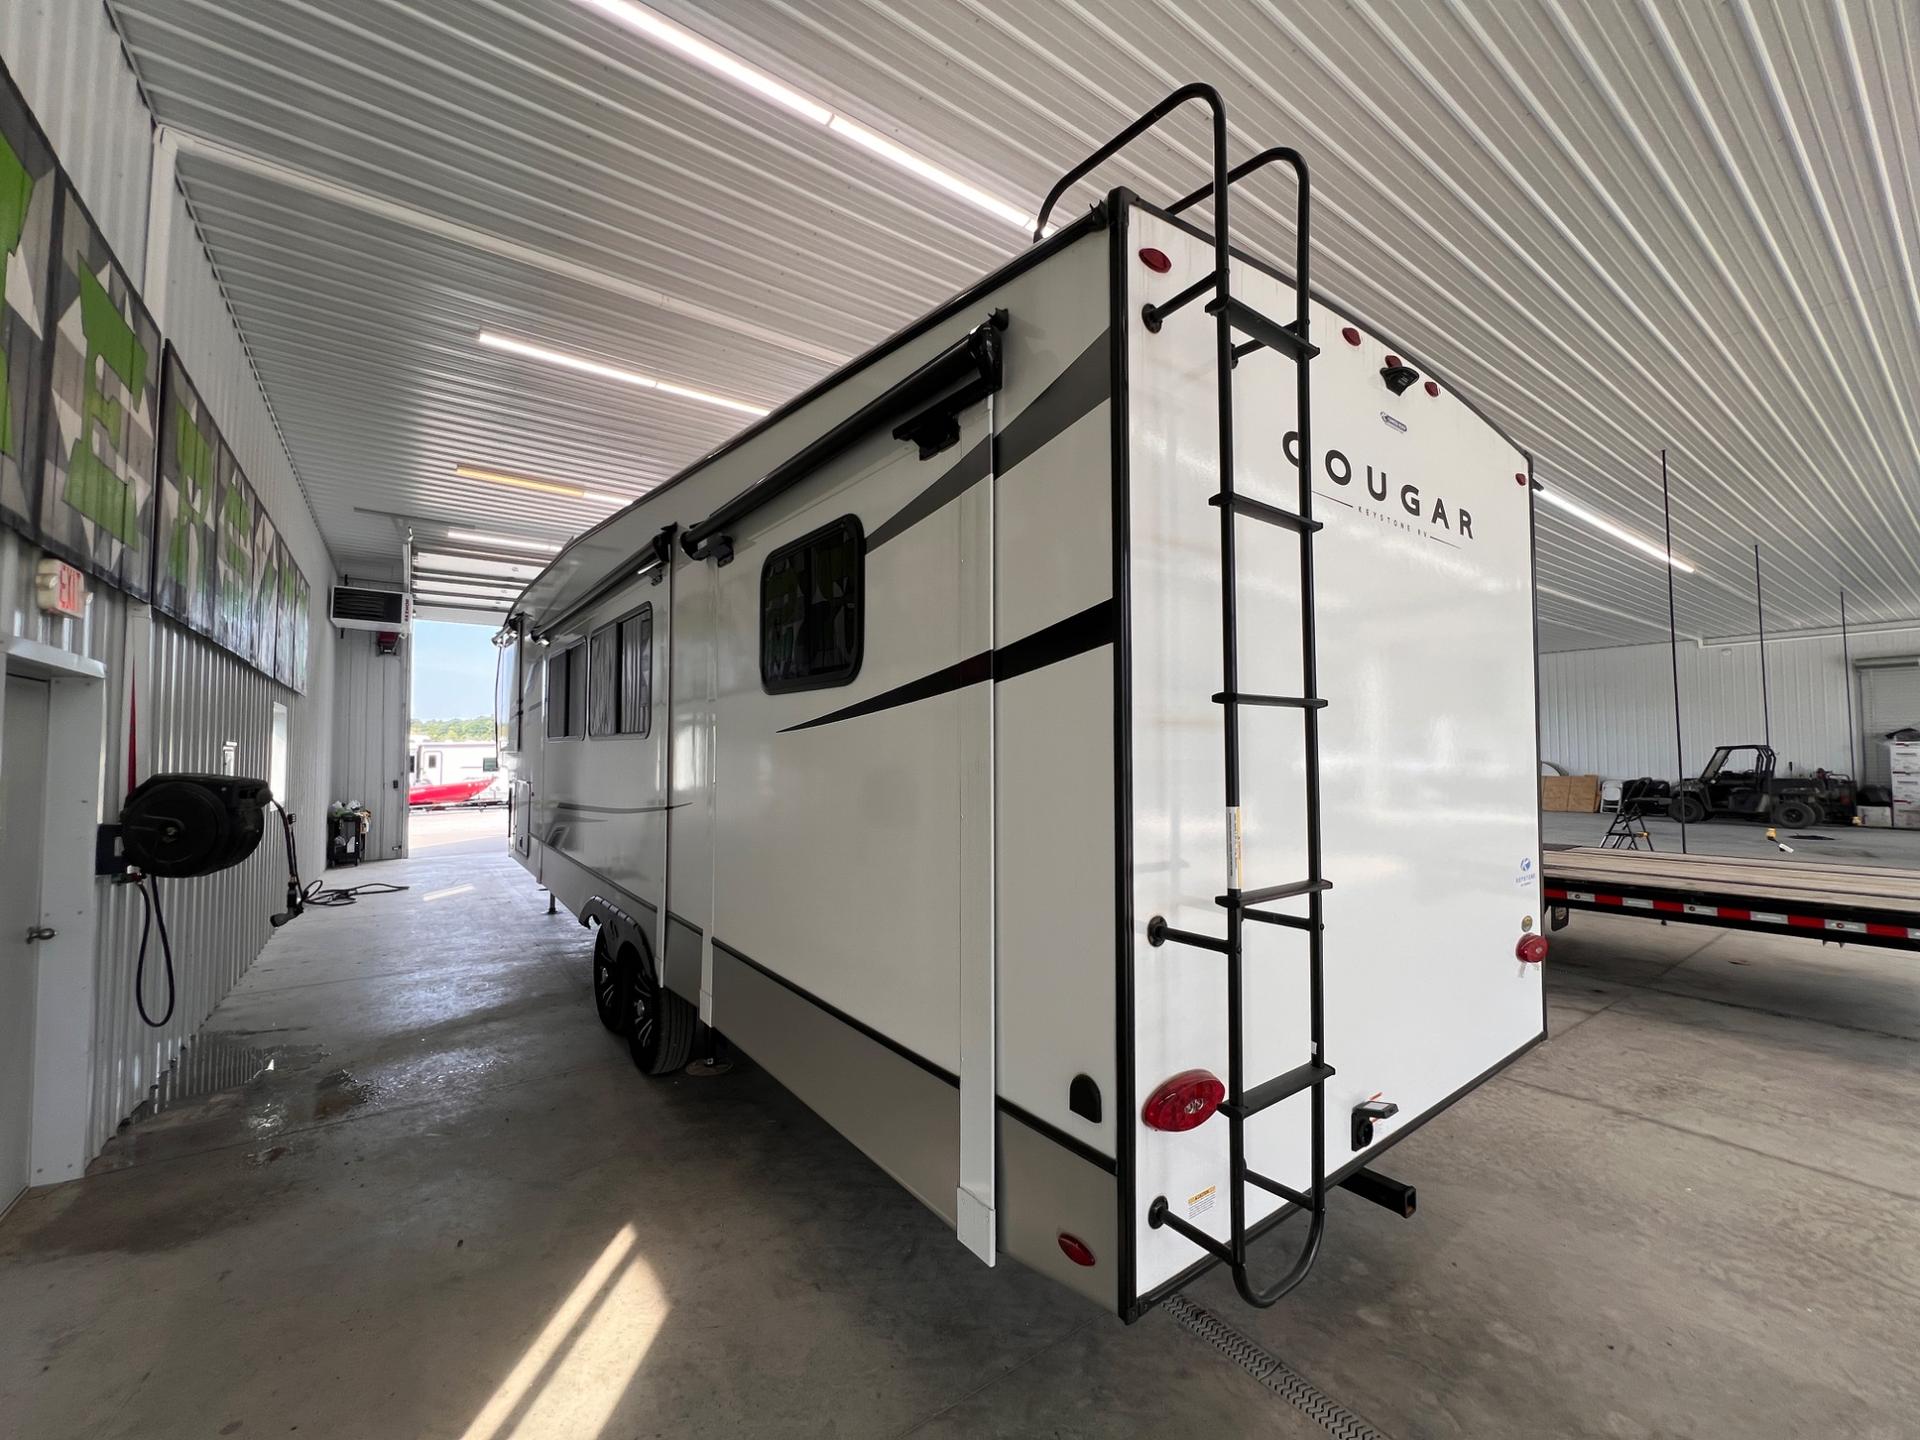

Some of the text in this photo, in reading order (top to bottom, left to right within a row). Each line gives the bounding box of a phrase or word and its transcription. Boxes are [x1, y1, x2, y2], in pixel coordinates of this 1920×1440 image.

[1282, 430, 1473, 539] COUGAR
[1358, 506, 1411, 532] KEYSTONE
[60, 565, 81, 611] EXIT
